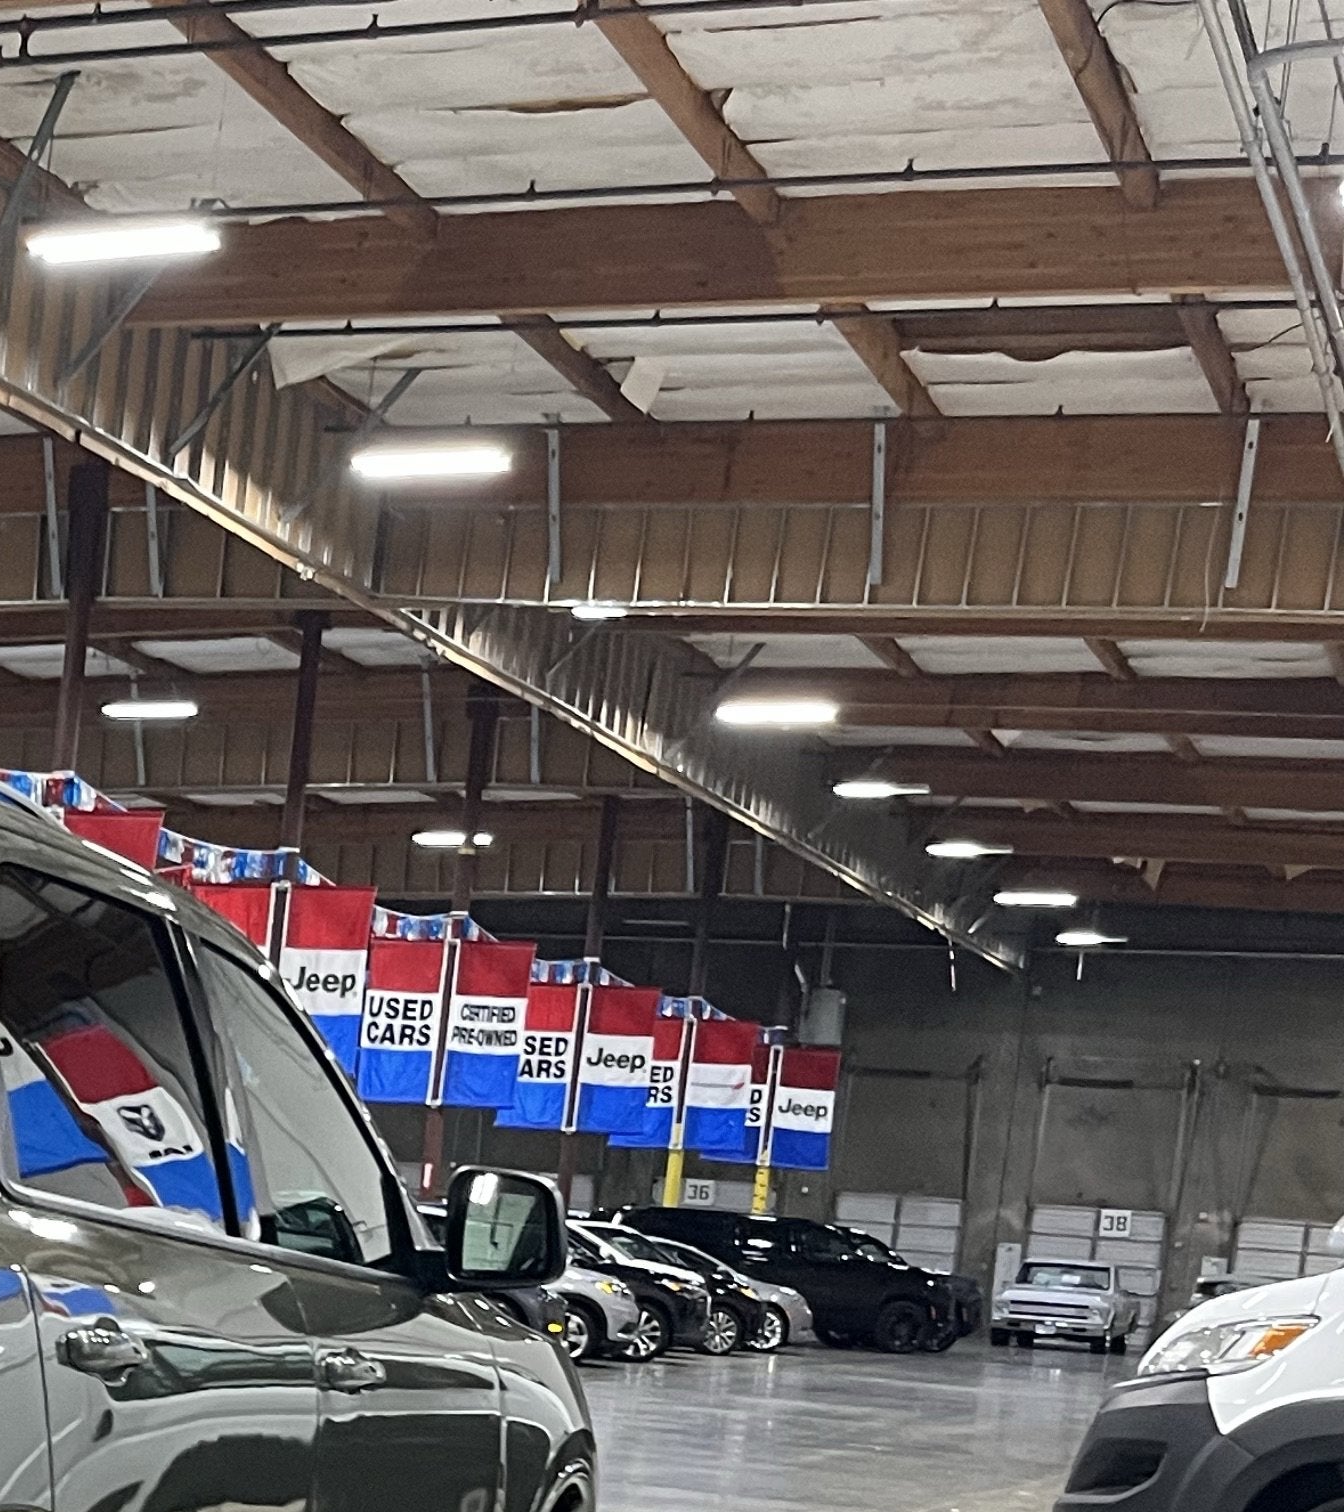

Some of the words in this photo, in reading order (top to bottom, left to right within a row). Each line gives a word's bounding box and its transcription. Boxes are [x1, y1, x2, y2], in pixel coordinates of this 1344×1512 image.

[286, 966, 357, 998] Jeep
[368, 996, 434, 1021] USED
[366, 1021, 432, 1046] CARS
[523, 1035, 569, 1057] SED
[519, 1058, 567, 1079] ARS
[586, 1047, 646, 1074] Jeep
[778, 1098, 829, 1121] Jeep
[686, 1183, 711, 1201] 36
[1102, 1215, 1129, 1232] 38
